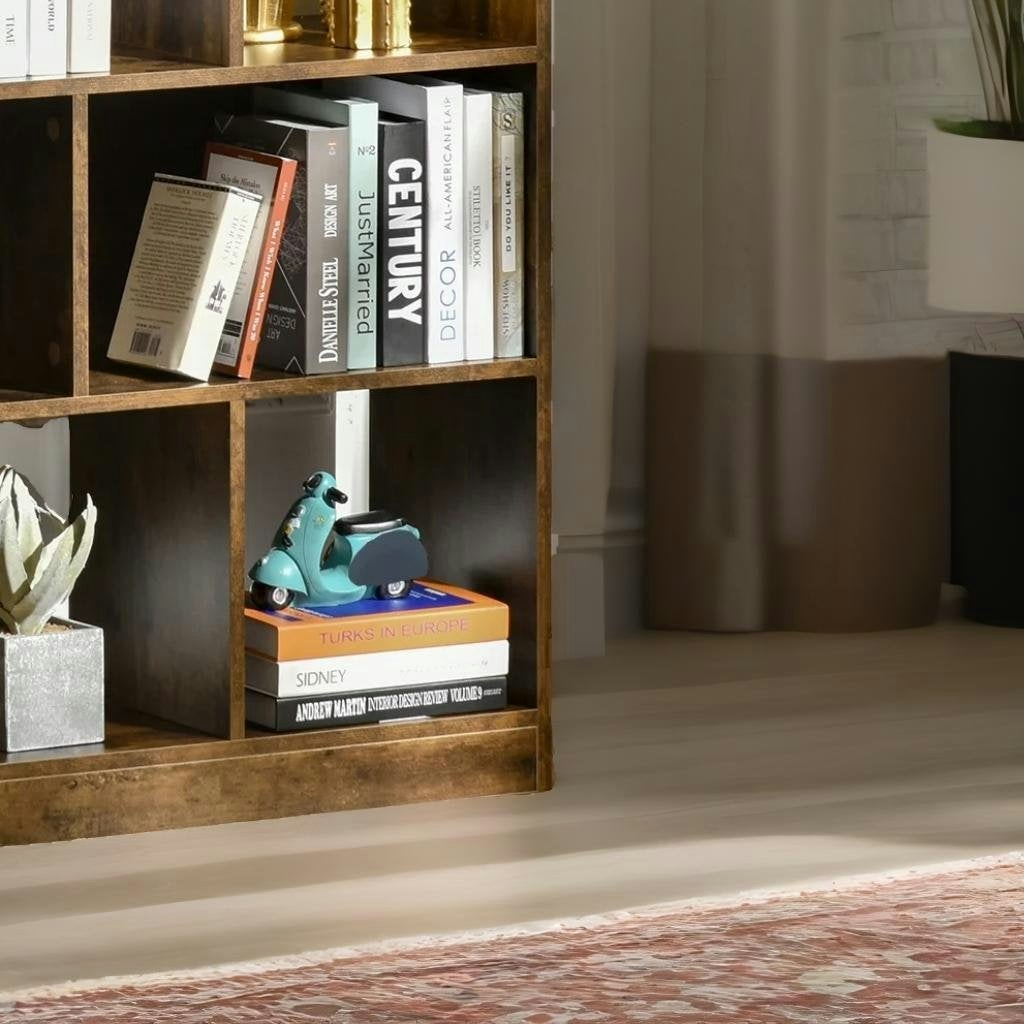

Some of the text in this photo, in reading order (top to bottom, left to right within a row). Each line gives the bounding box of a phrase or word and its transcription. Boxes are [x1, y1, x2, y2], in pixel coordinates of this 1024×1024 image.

[5, 16, 15, 45] TIME
[505, 166, 512, 176] IT
[324, 183, 337, 238] DESIGN ART
[387, 158, 422, 325] CENTURY
[505, 236, 512, 252] DO
[318, 258, 339, 363] DANIELLE STEEL
[440, 249, 456, 341] DECOR
[320, 619, 470, 645] TURKS IN EUROPE
[296, 668, 346, 687] SIDNEY
[296, 701, 333, 722] ANDREW
[334, 697, 366, 718] MARTIN
[368, 694, 399, 712] INTERIOR
[399, 691, 423, 708] DESIGN
[423, 689, 449, 706] REVIEW
[450, 686, 477, 702] VOLUME
